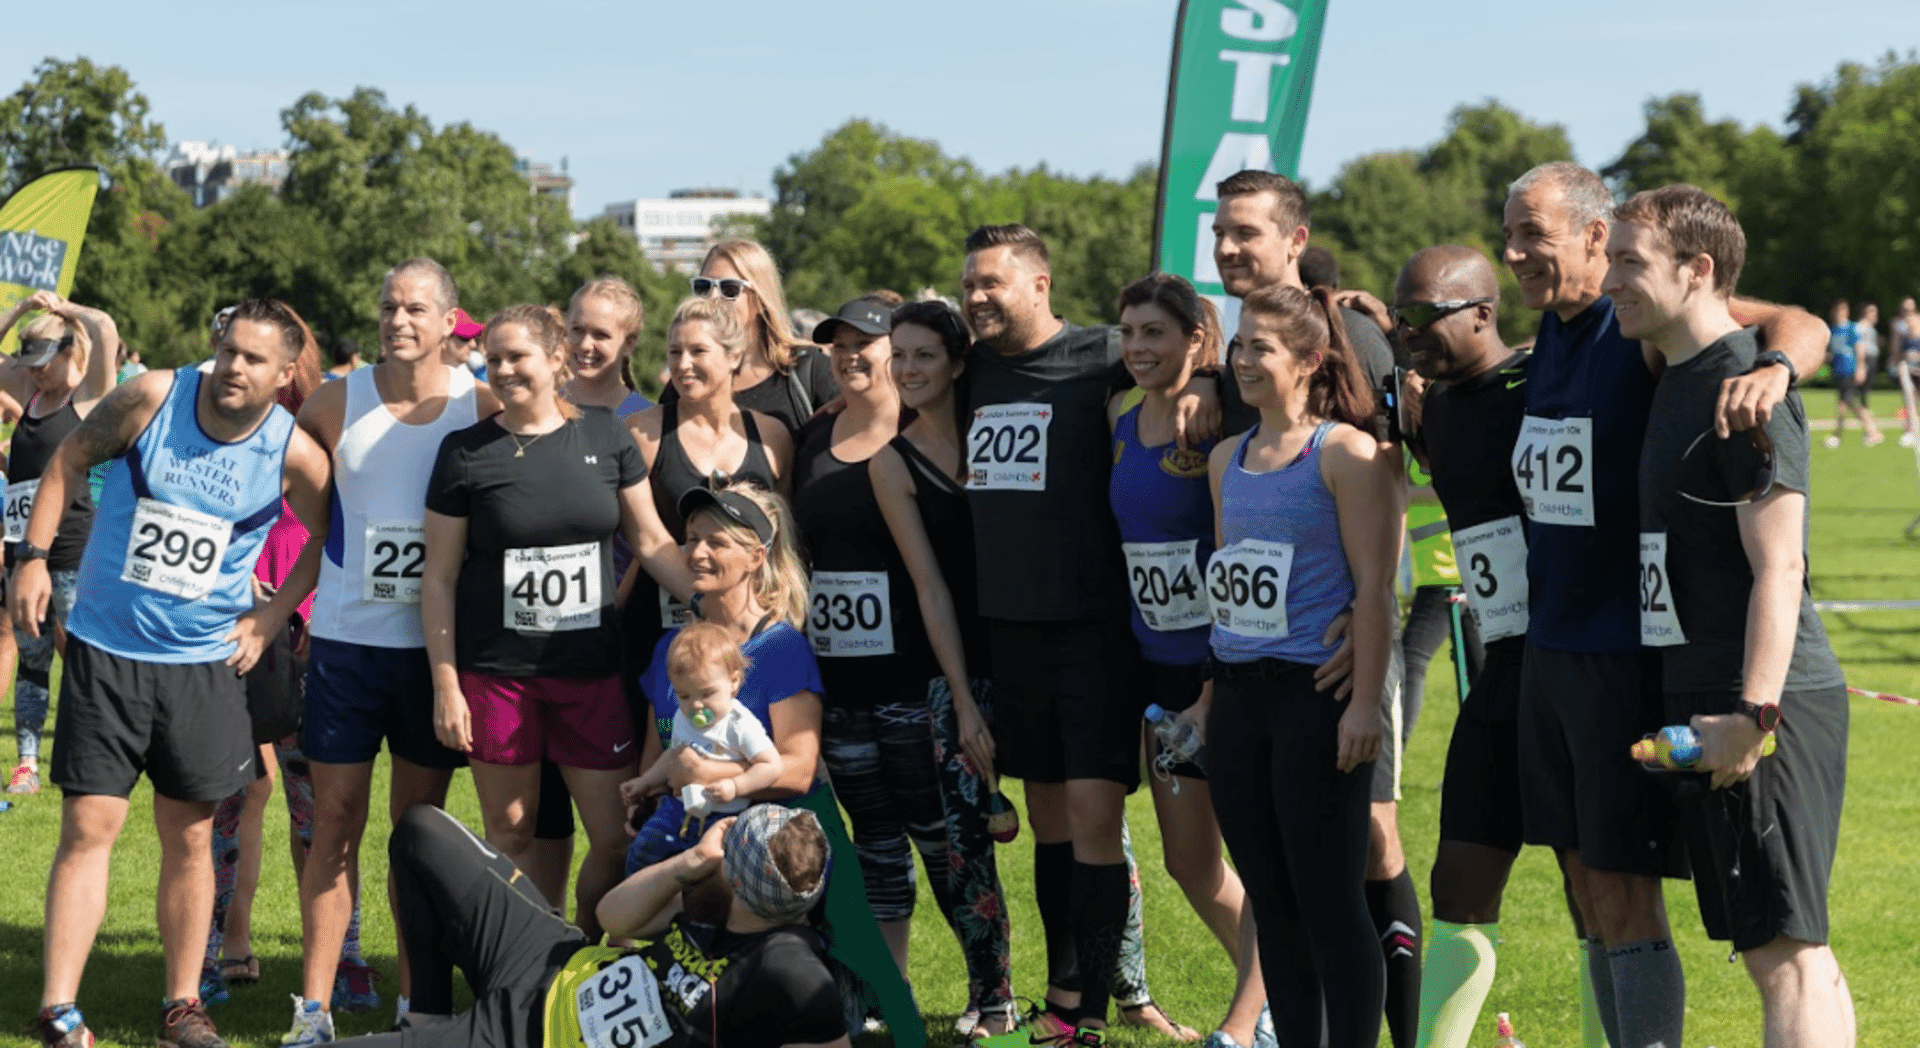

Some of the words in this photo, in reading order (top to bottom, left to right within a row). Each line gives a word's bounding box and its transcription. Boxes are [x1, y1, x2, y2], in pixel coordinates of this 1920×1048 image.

[3, 228, 60, 262] Nice
[184, 443, 237, 472] GREAT
[972, 424, 1040, 464] 202
[169, 456, 241, 493] WESTERN
[1517, 443, 1584, 493] 412
[164, 471, 236, 507] RUNNERS
[133, 522, 217, 574] 299
[375, 525, 406, 533] London
[371, 540, 427, 578] 22
[1470, 552, 1498, 599] 3
[511, 566, 588, 607] 401
[1133, 564, 1198, 607] 204
[1210, 560, 1279, 610] 366
[811, 592, 883, 632] 330
[598, 966, 649, 1048] 315
